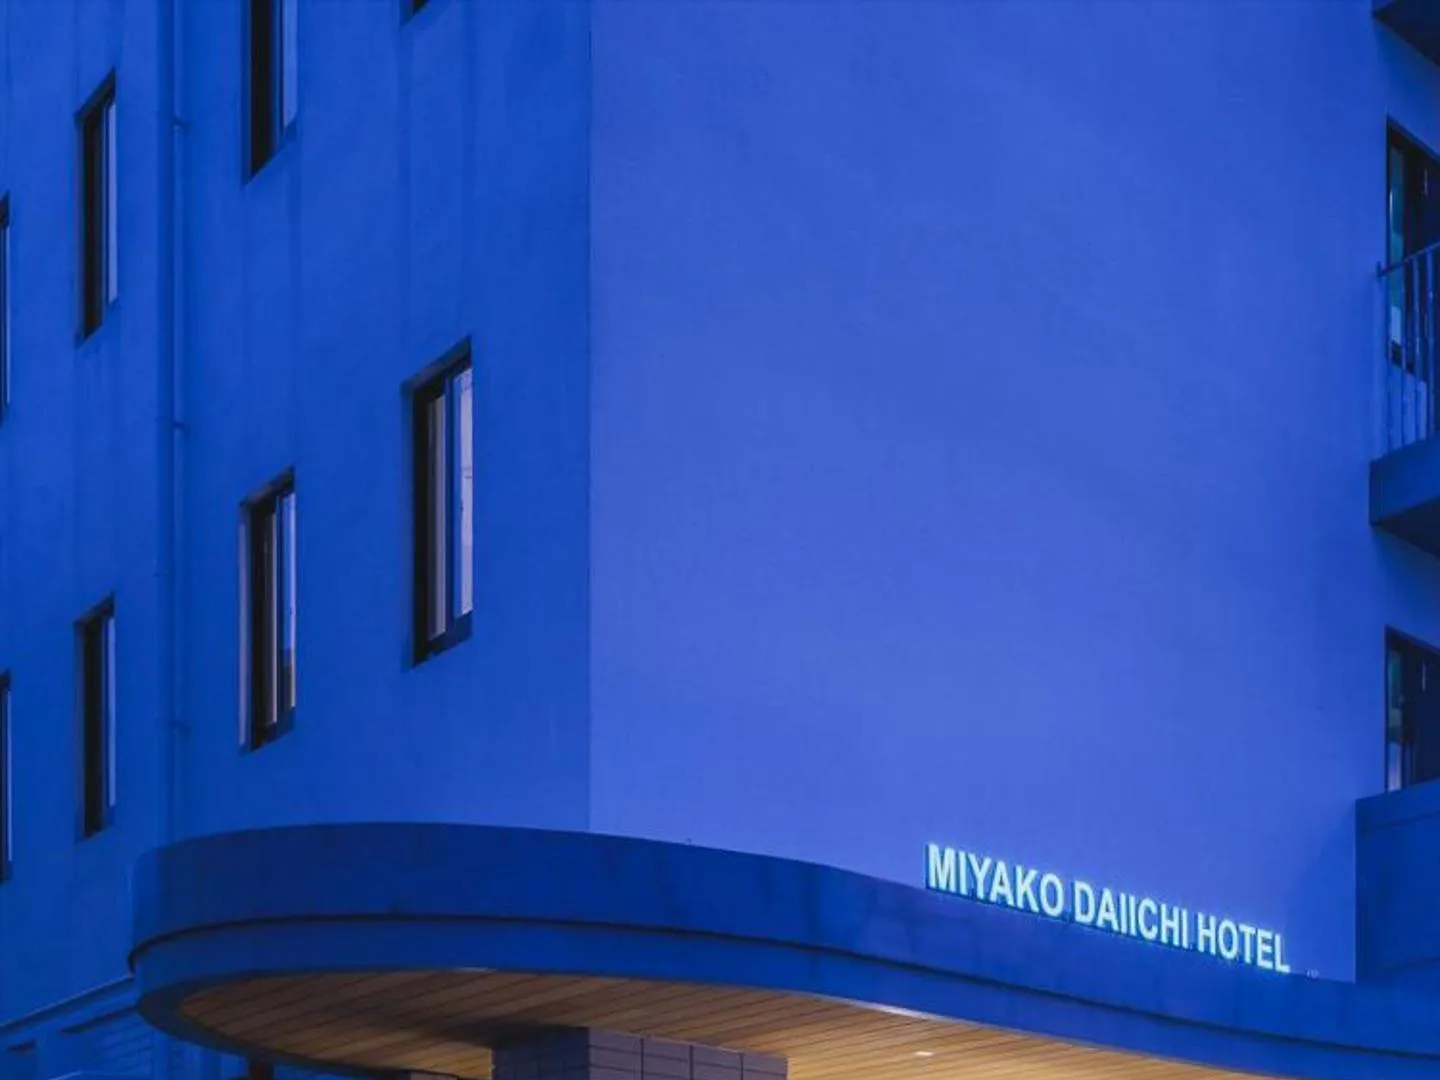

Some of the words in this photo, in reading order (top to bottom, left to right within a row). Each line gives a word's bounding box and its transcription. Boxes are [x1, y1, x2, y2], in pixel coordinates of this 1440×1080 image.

[926, 843, 1064, 918] MIYAKO
[1073, 880, 1190, 949] DAIICHI
[1197, 912, 1291, 974] HOTEL
